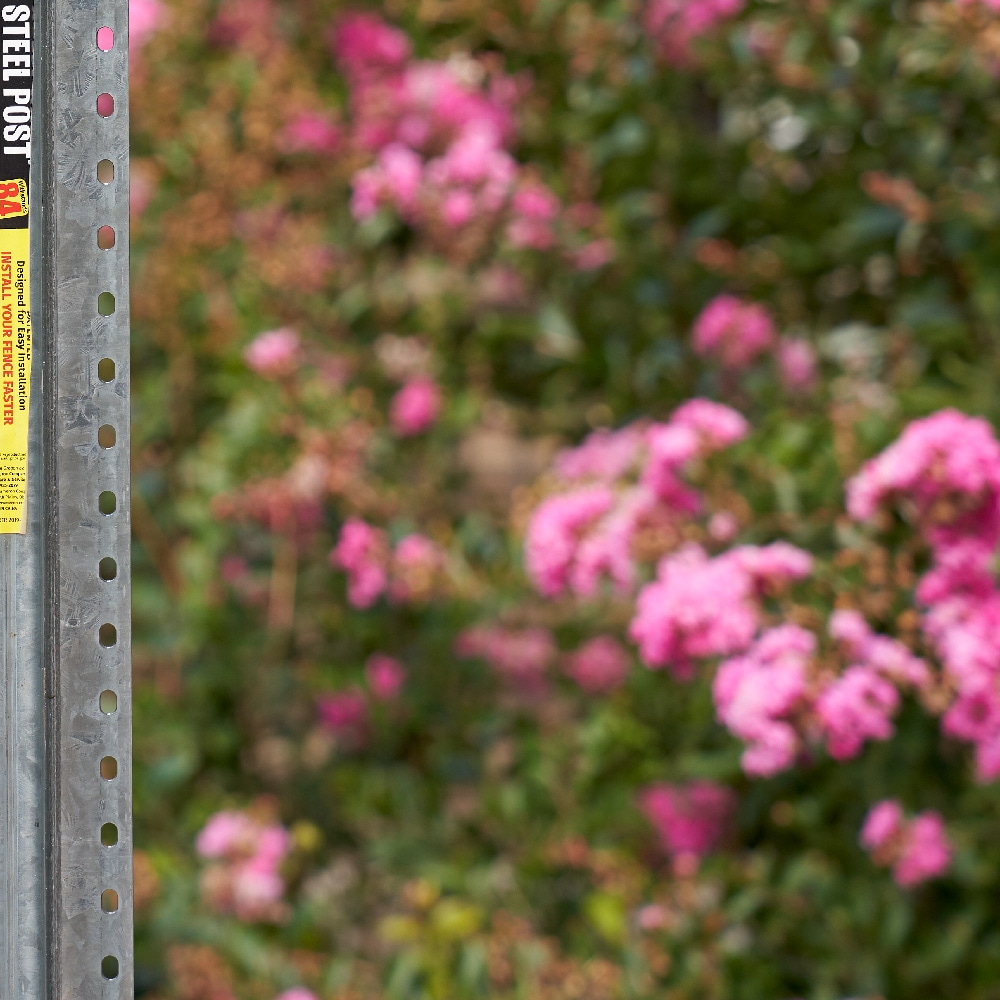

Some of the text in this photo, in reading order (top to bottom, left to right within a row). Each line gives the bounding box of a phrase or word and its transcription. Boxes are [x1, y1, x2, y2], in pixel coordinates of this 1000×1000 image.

[2, 4, 31, 82] STEEL
[3, 88, 31, 158] POST
[1, 251, 14, 425] INSTALL YOUR FENCE FASTER
[15, 260, 27, 411] Designed for Easy Installation
